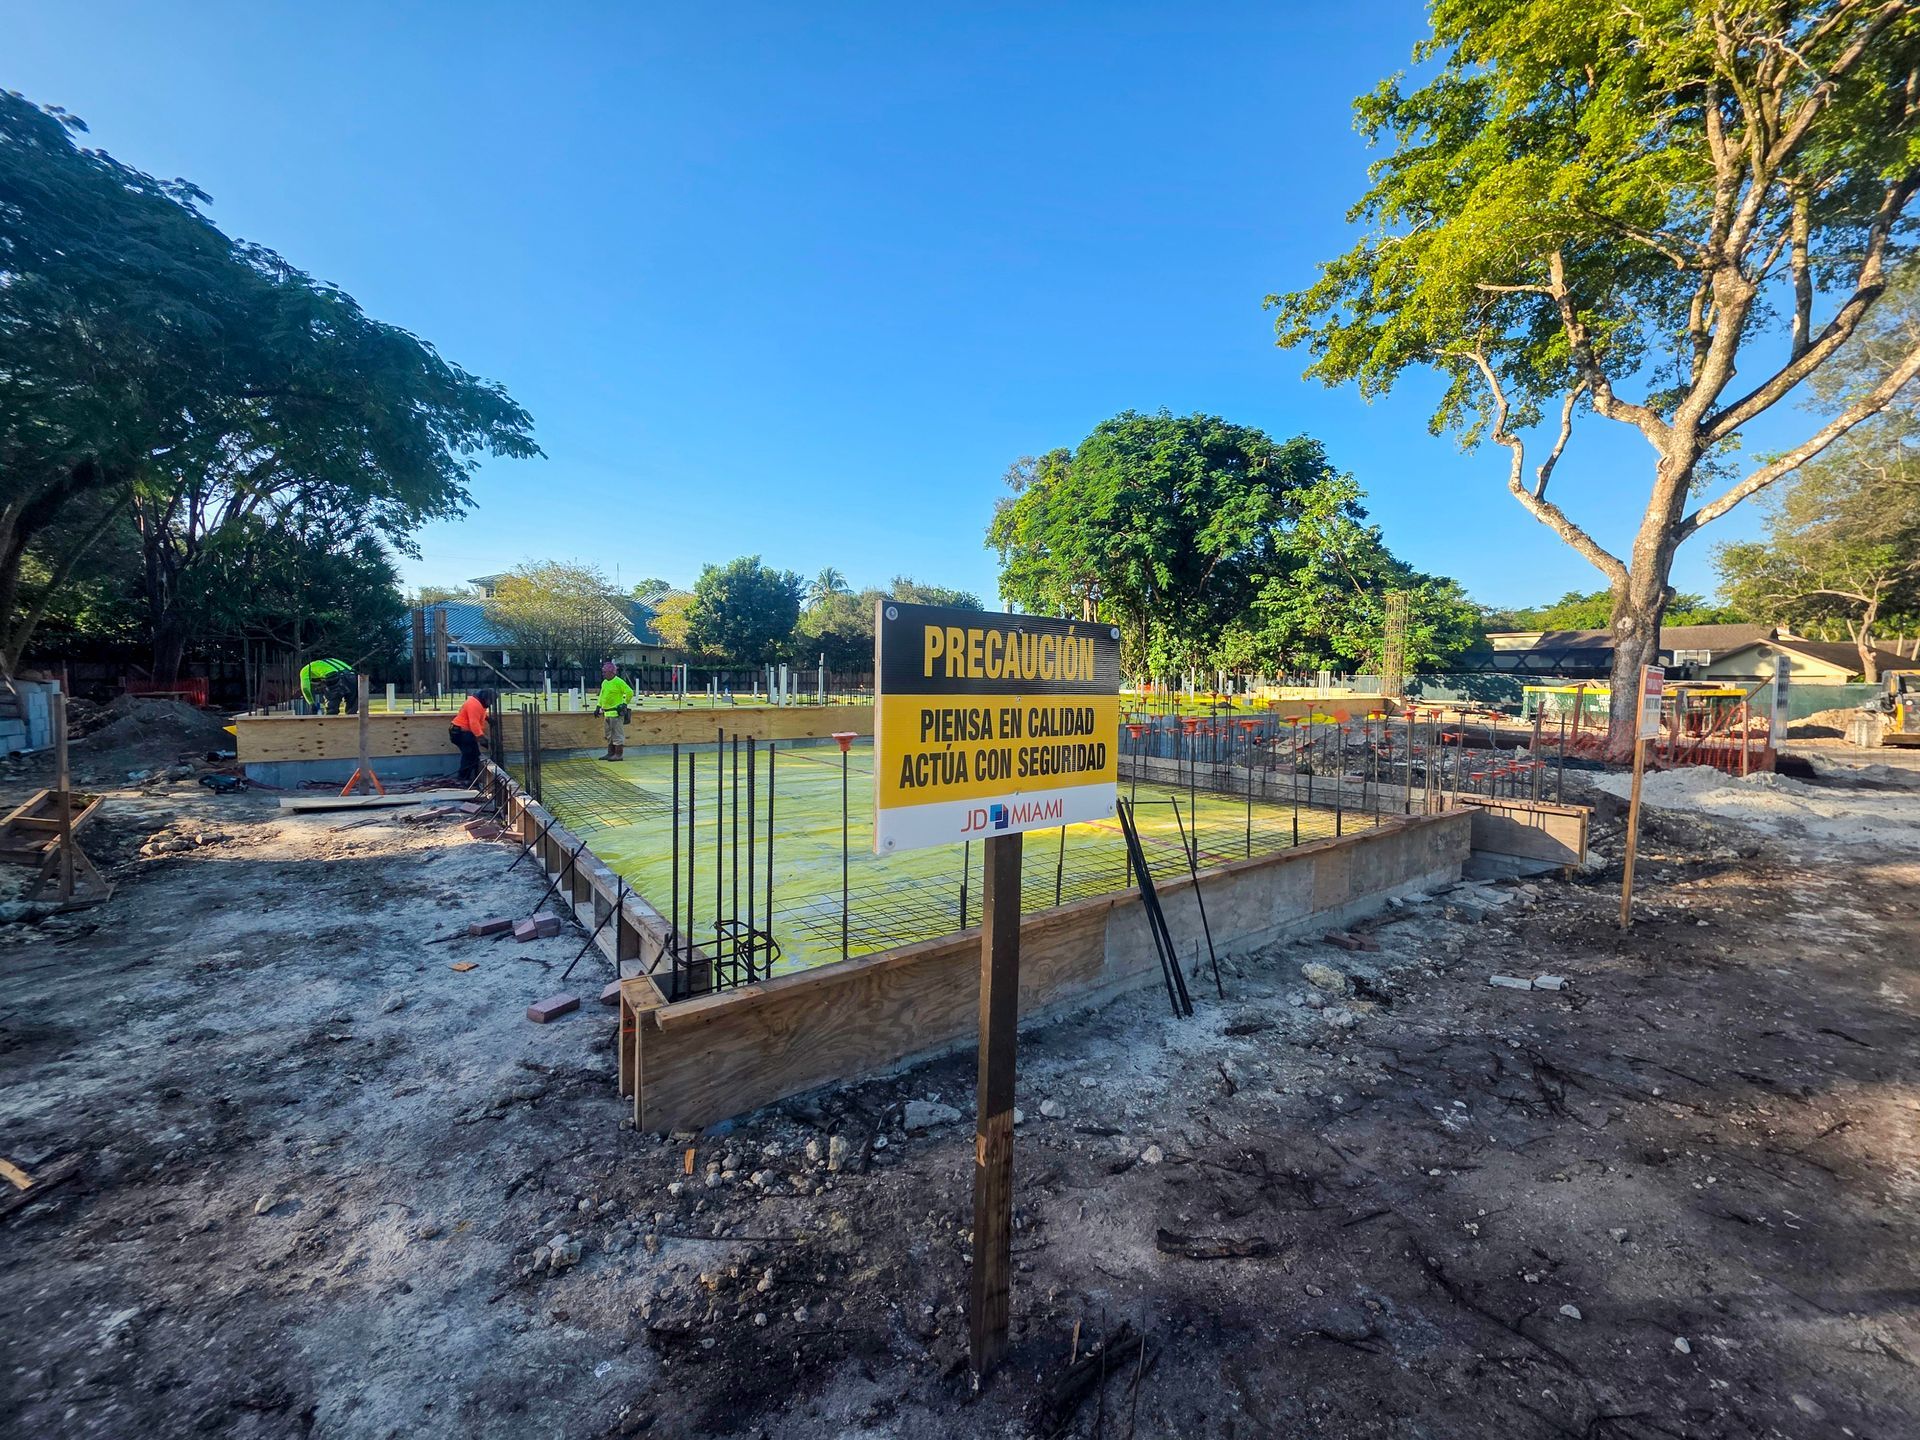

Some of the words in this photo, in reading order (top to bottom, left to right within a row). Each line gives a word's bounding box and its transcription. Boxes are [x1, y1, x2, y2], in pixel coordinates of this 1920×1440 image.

[924, 625, 1094, 681] PRECAUCIÓN
[920, 708, 993, 743] PIENSA
[999, 708, 1022, 739] EN
[1028, 707, 1094, 738] CALIDAD
[899, 743, 968, 789] ACTÚA
[975, 748, 1011, 782] CON
[1018, 742, 1106, 777] SEGURIDAD
[961, 808, 988, 832] JD
[1011, 798, 1063, 825] MIAMI
